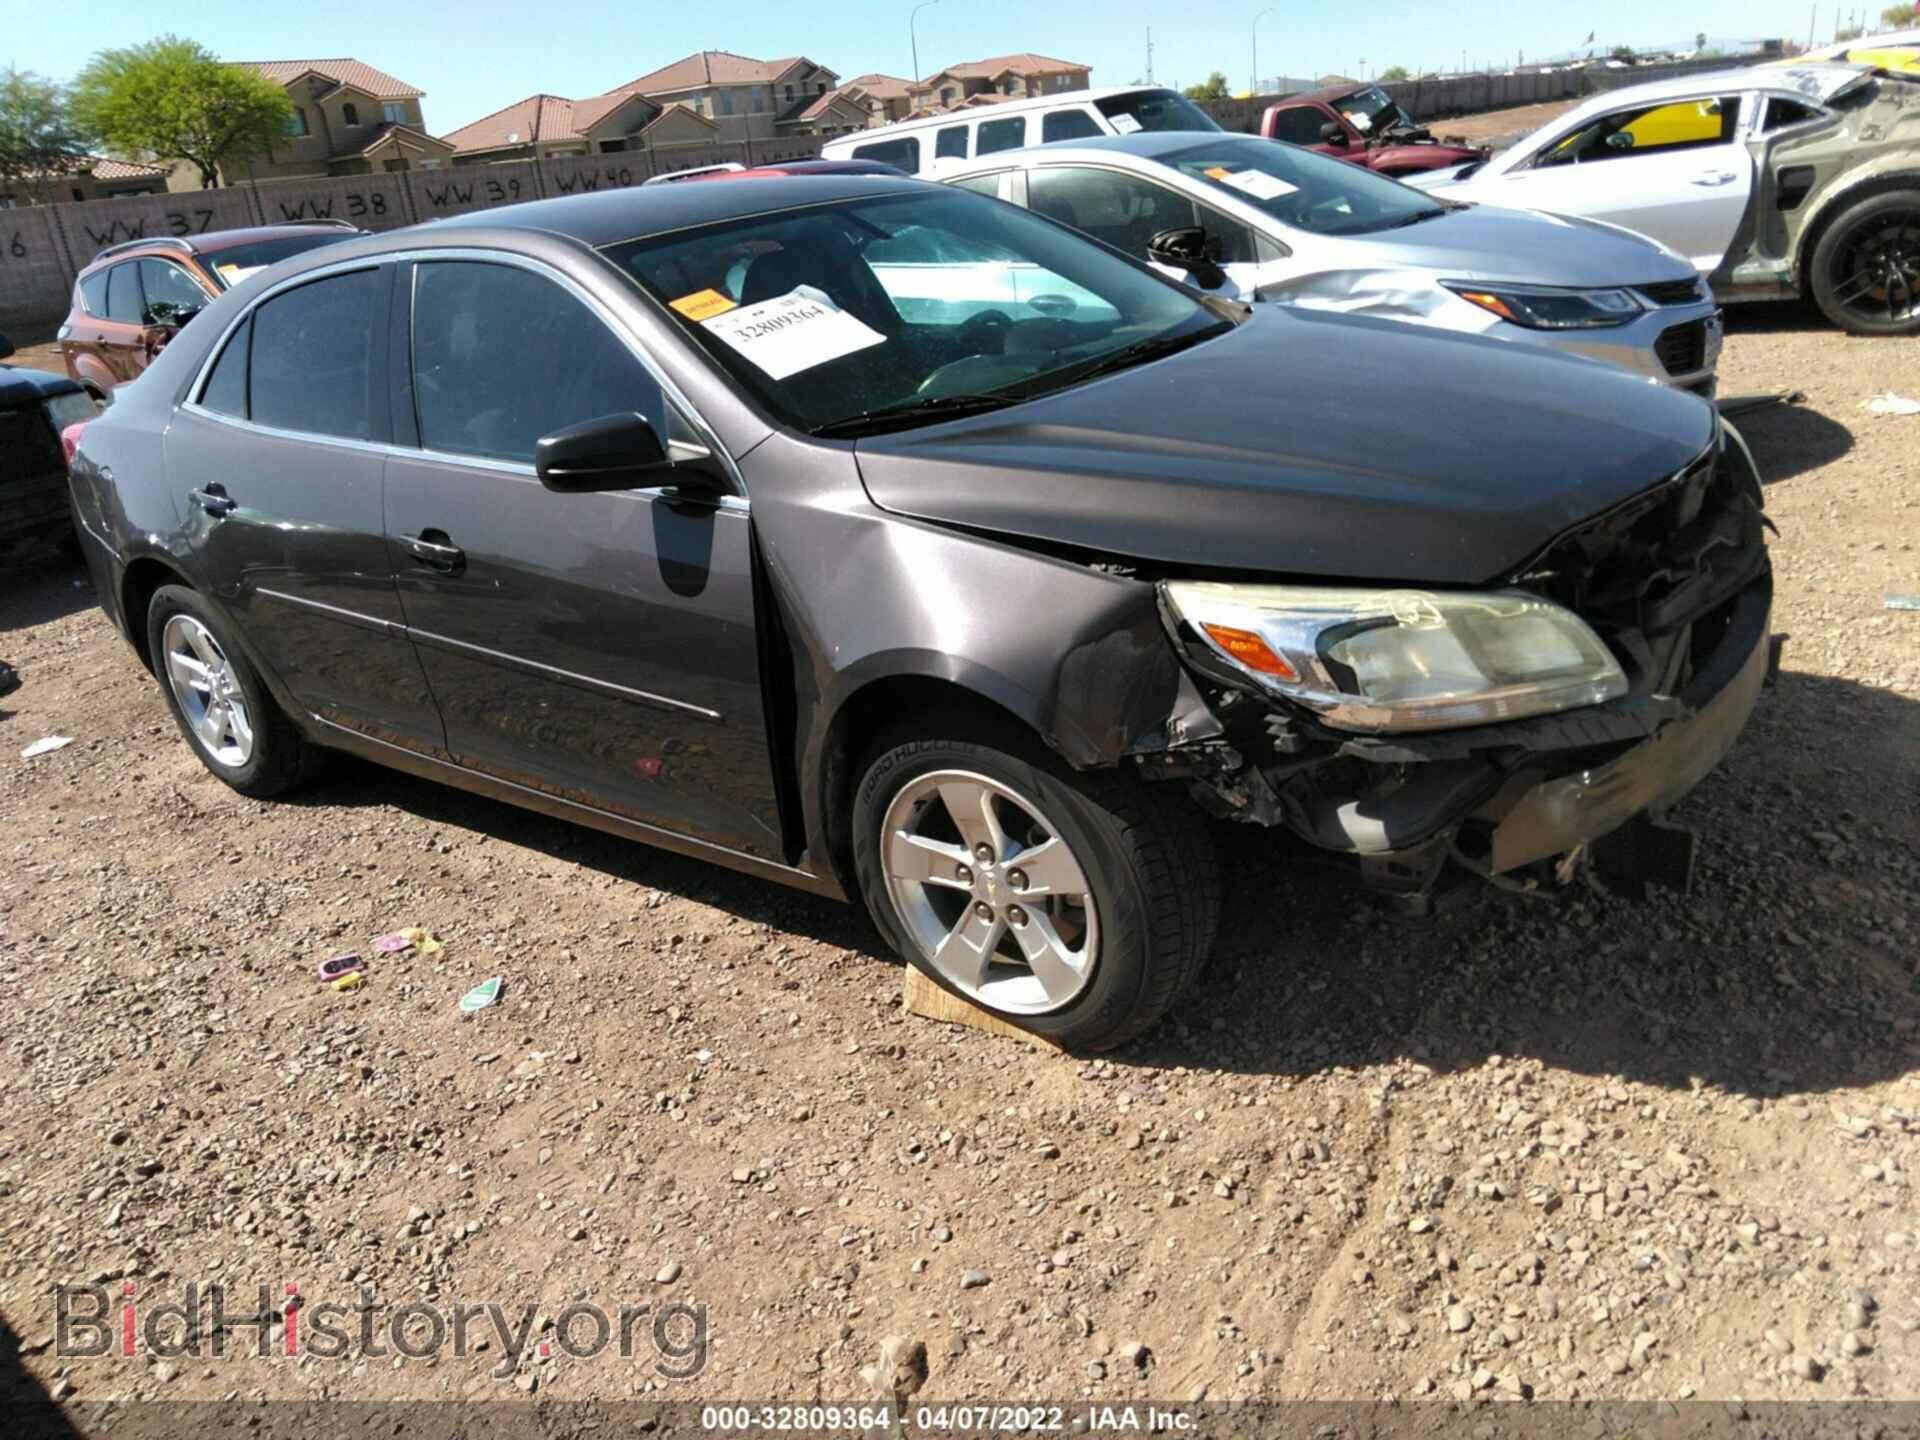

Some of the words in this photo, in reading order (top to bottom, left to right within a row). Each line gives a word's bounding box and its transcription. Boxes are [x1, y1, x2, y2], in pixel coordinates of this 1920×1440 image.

[425, 184, 474, 207] WW
[486, 179, 521, 201] 39
[555, 171, 599, 193] WW
[607, 168, 633, 186] 40
[280, 198, 333, 221] WW
[346, 193, 387, 216] 38
[84, 217, 145, 247] WW
[166, 209, 214, 237] 37
[734, 305, 825, 343] 32809364
